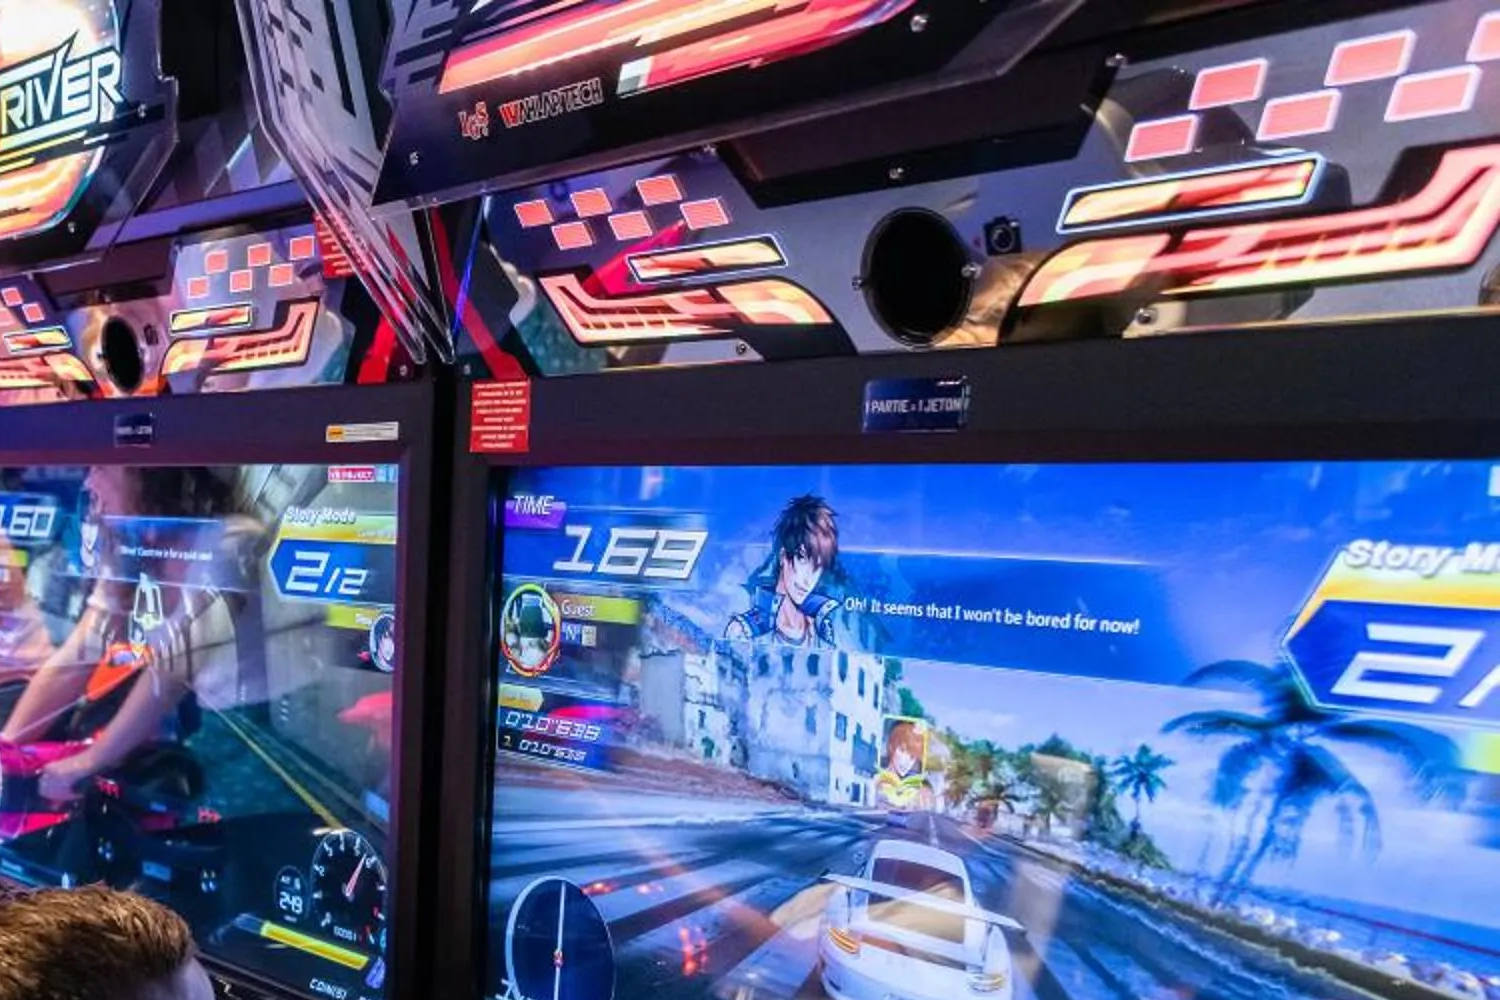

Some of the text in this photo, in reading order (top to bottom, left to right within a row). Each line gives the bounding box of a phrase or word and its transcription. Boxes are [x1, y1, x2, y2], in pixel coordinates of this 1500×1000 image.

[871, 400, 910, 414] PARTIE
[286, 506, 357, 527] Story Mode
[514, 495, 554, 516] TIME
[552, 524, 708, 580] 169
[1346, 538, 1500, 580] Story M
[284, 550, 369, 596] 2/2
[561, 599, 596, 617] Guest
[845, 597, 866, 612] Oh!
[883, 602, 923, 617] seems
[926, 602, 952, 620] that
[963, 606, 1002, 624] won't
[1004, 606, 1022, 625] be
[1026, 609, 1071, 630] bored
[1073, 612, 1097, 632] for
[1100, 617, 1140, 635] now!
